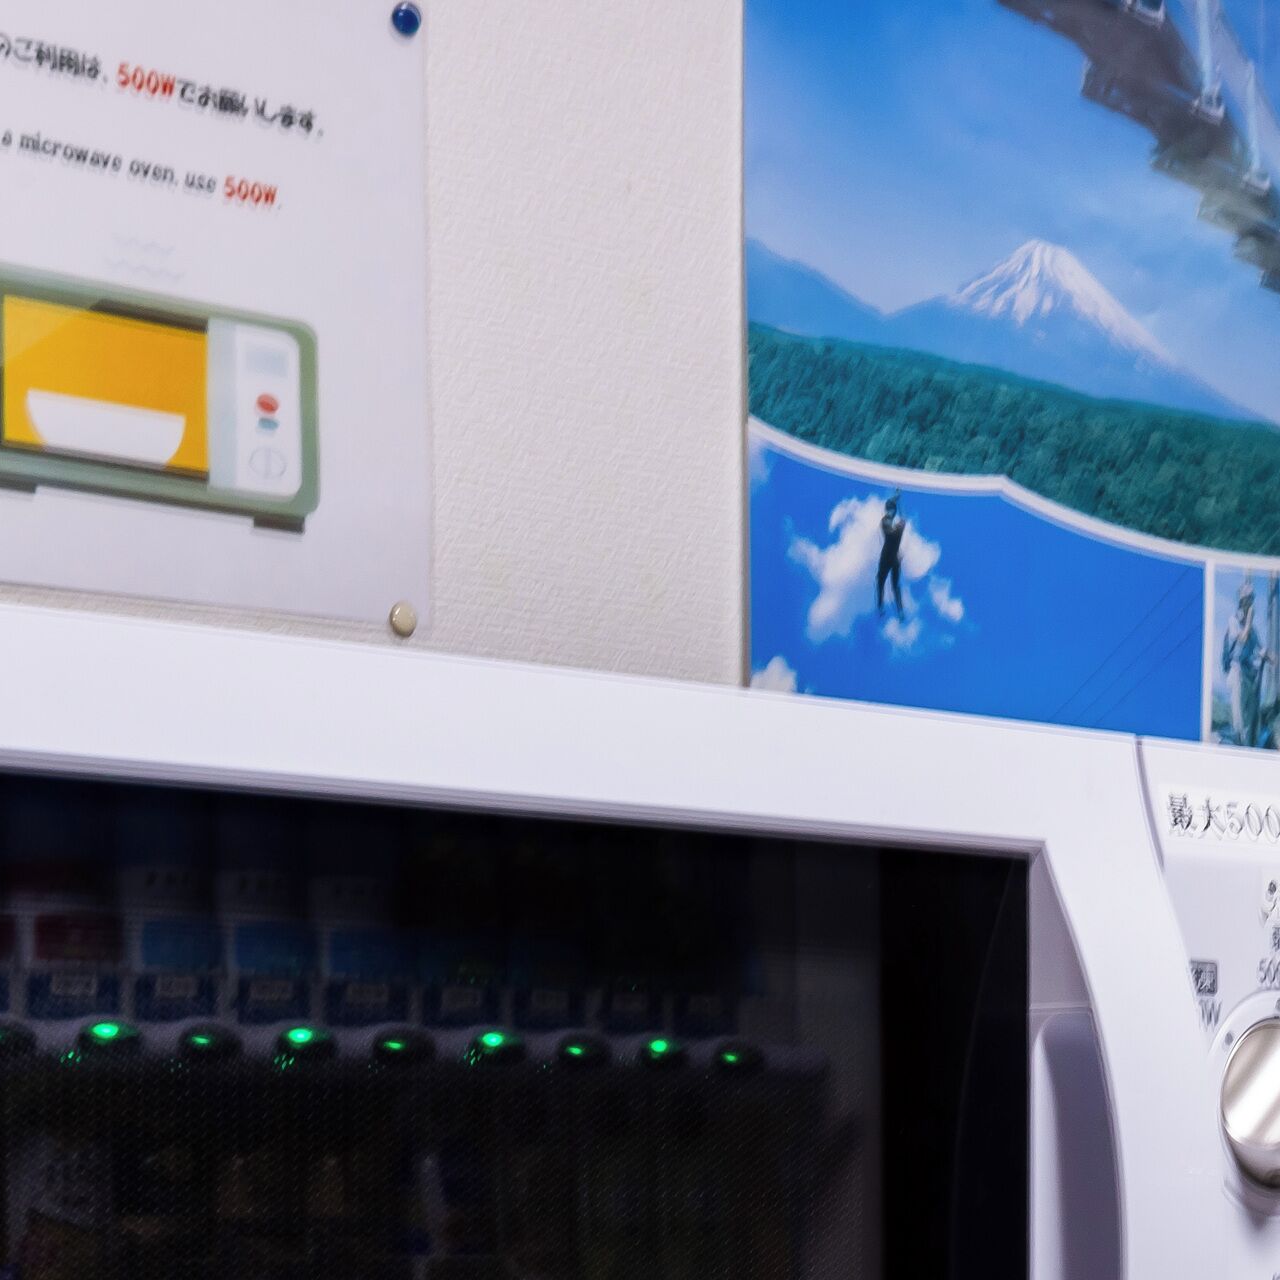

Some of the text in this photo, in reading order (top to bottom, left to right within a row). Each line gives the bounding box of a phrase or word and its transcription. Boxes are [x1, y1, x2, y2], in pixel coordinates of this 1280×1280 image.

[1, 130, 13, 147] a
[19, 133, 122, 172] microwave
[184, 172, 216, 193] use
